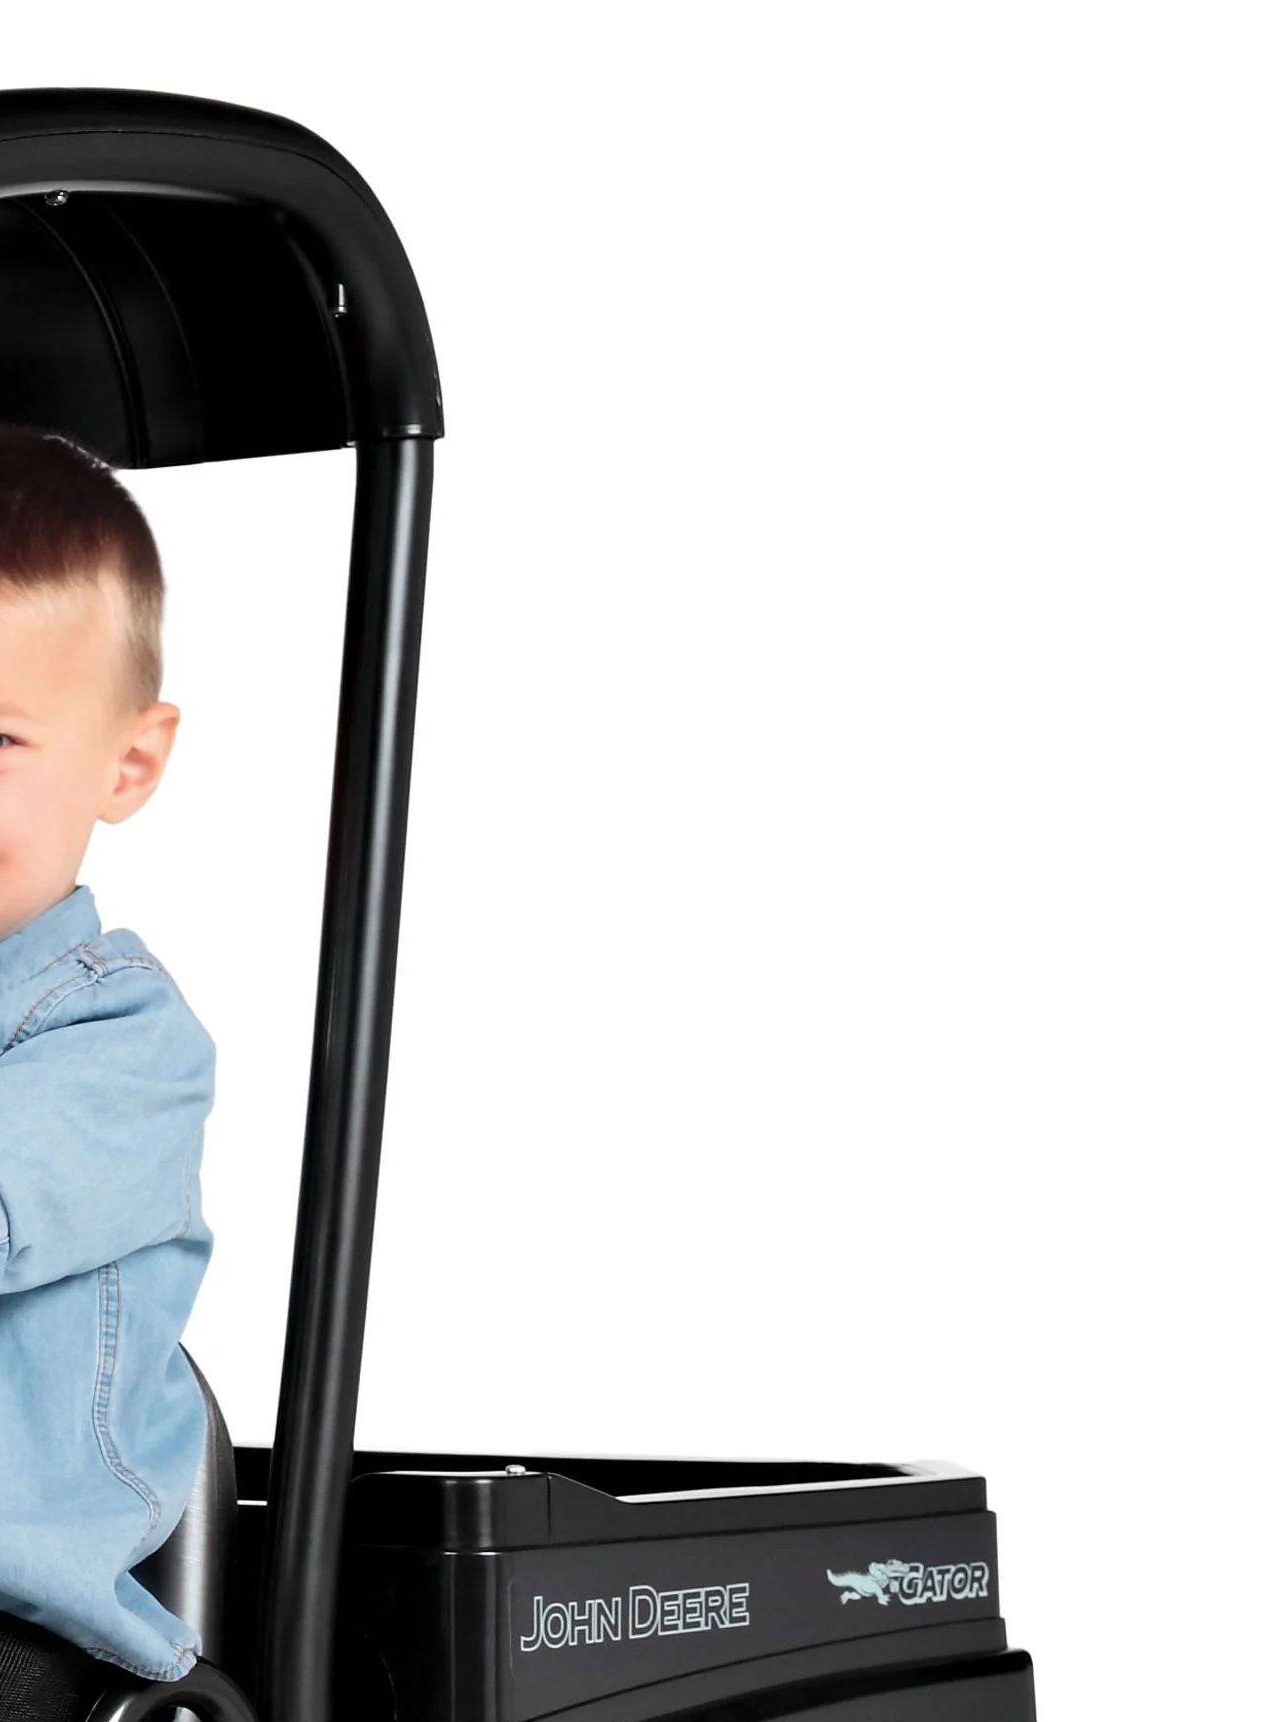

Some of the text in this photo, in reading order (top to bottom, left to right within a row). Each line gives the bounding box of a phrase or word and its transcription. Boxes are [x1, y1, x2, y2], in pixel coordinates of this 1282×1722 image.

[898, 1562, 989, 1606] GATOR
[521, 1583, 749, 1652] JOHN DEERE
